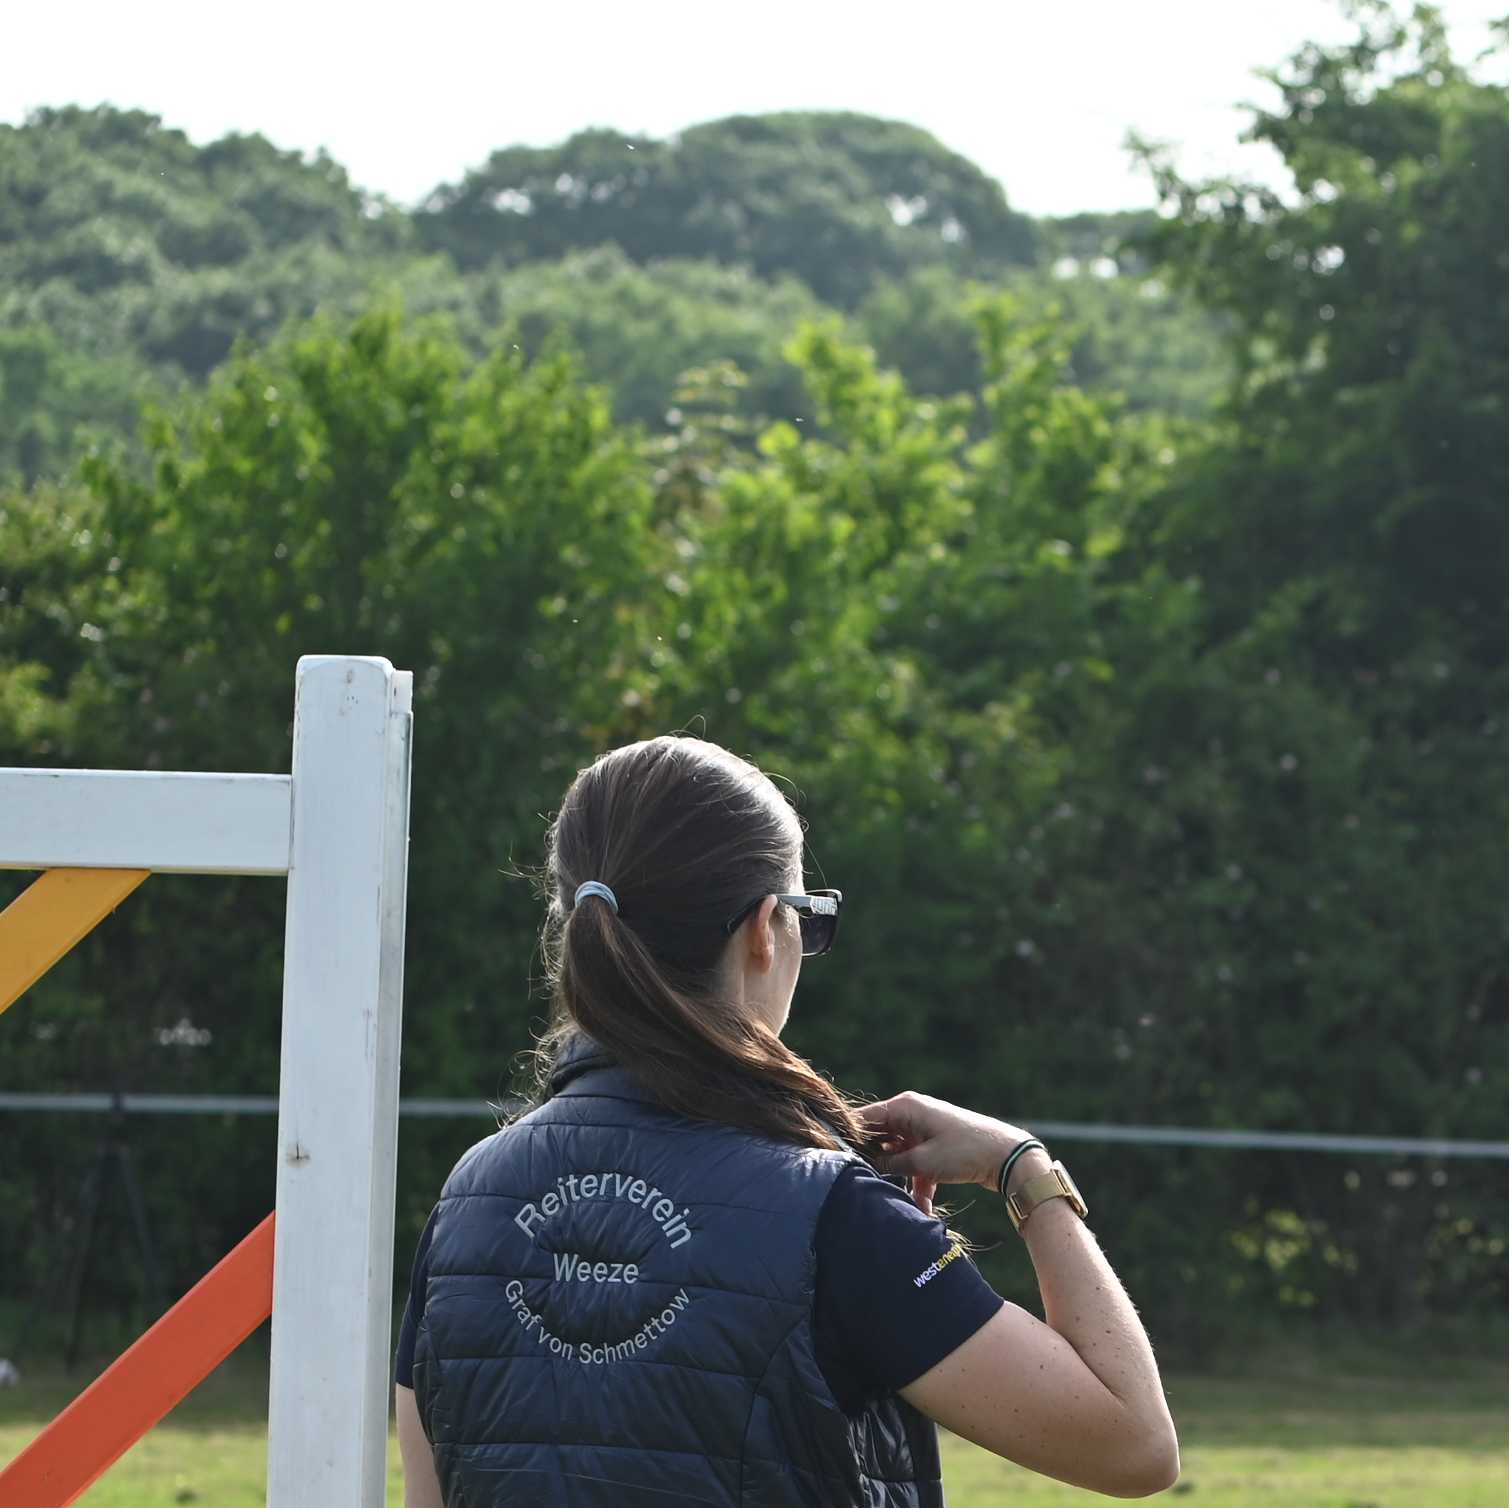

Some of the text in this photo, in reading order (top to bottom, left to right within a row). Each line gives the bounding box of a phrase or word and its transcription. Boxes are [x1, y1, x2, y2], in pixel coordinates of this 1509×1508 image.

[514, 1173, 692, 1249] Reiterverein
[553, 1253, 639, 1284] Weeze
[505, 1280, 691, 1364] Graf von Schmettow
